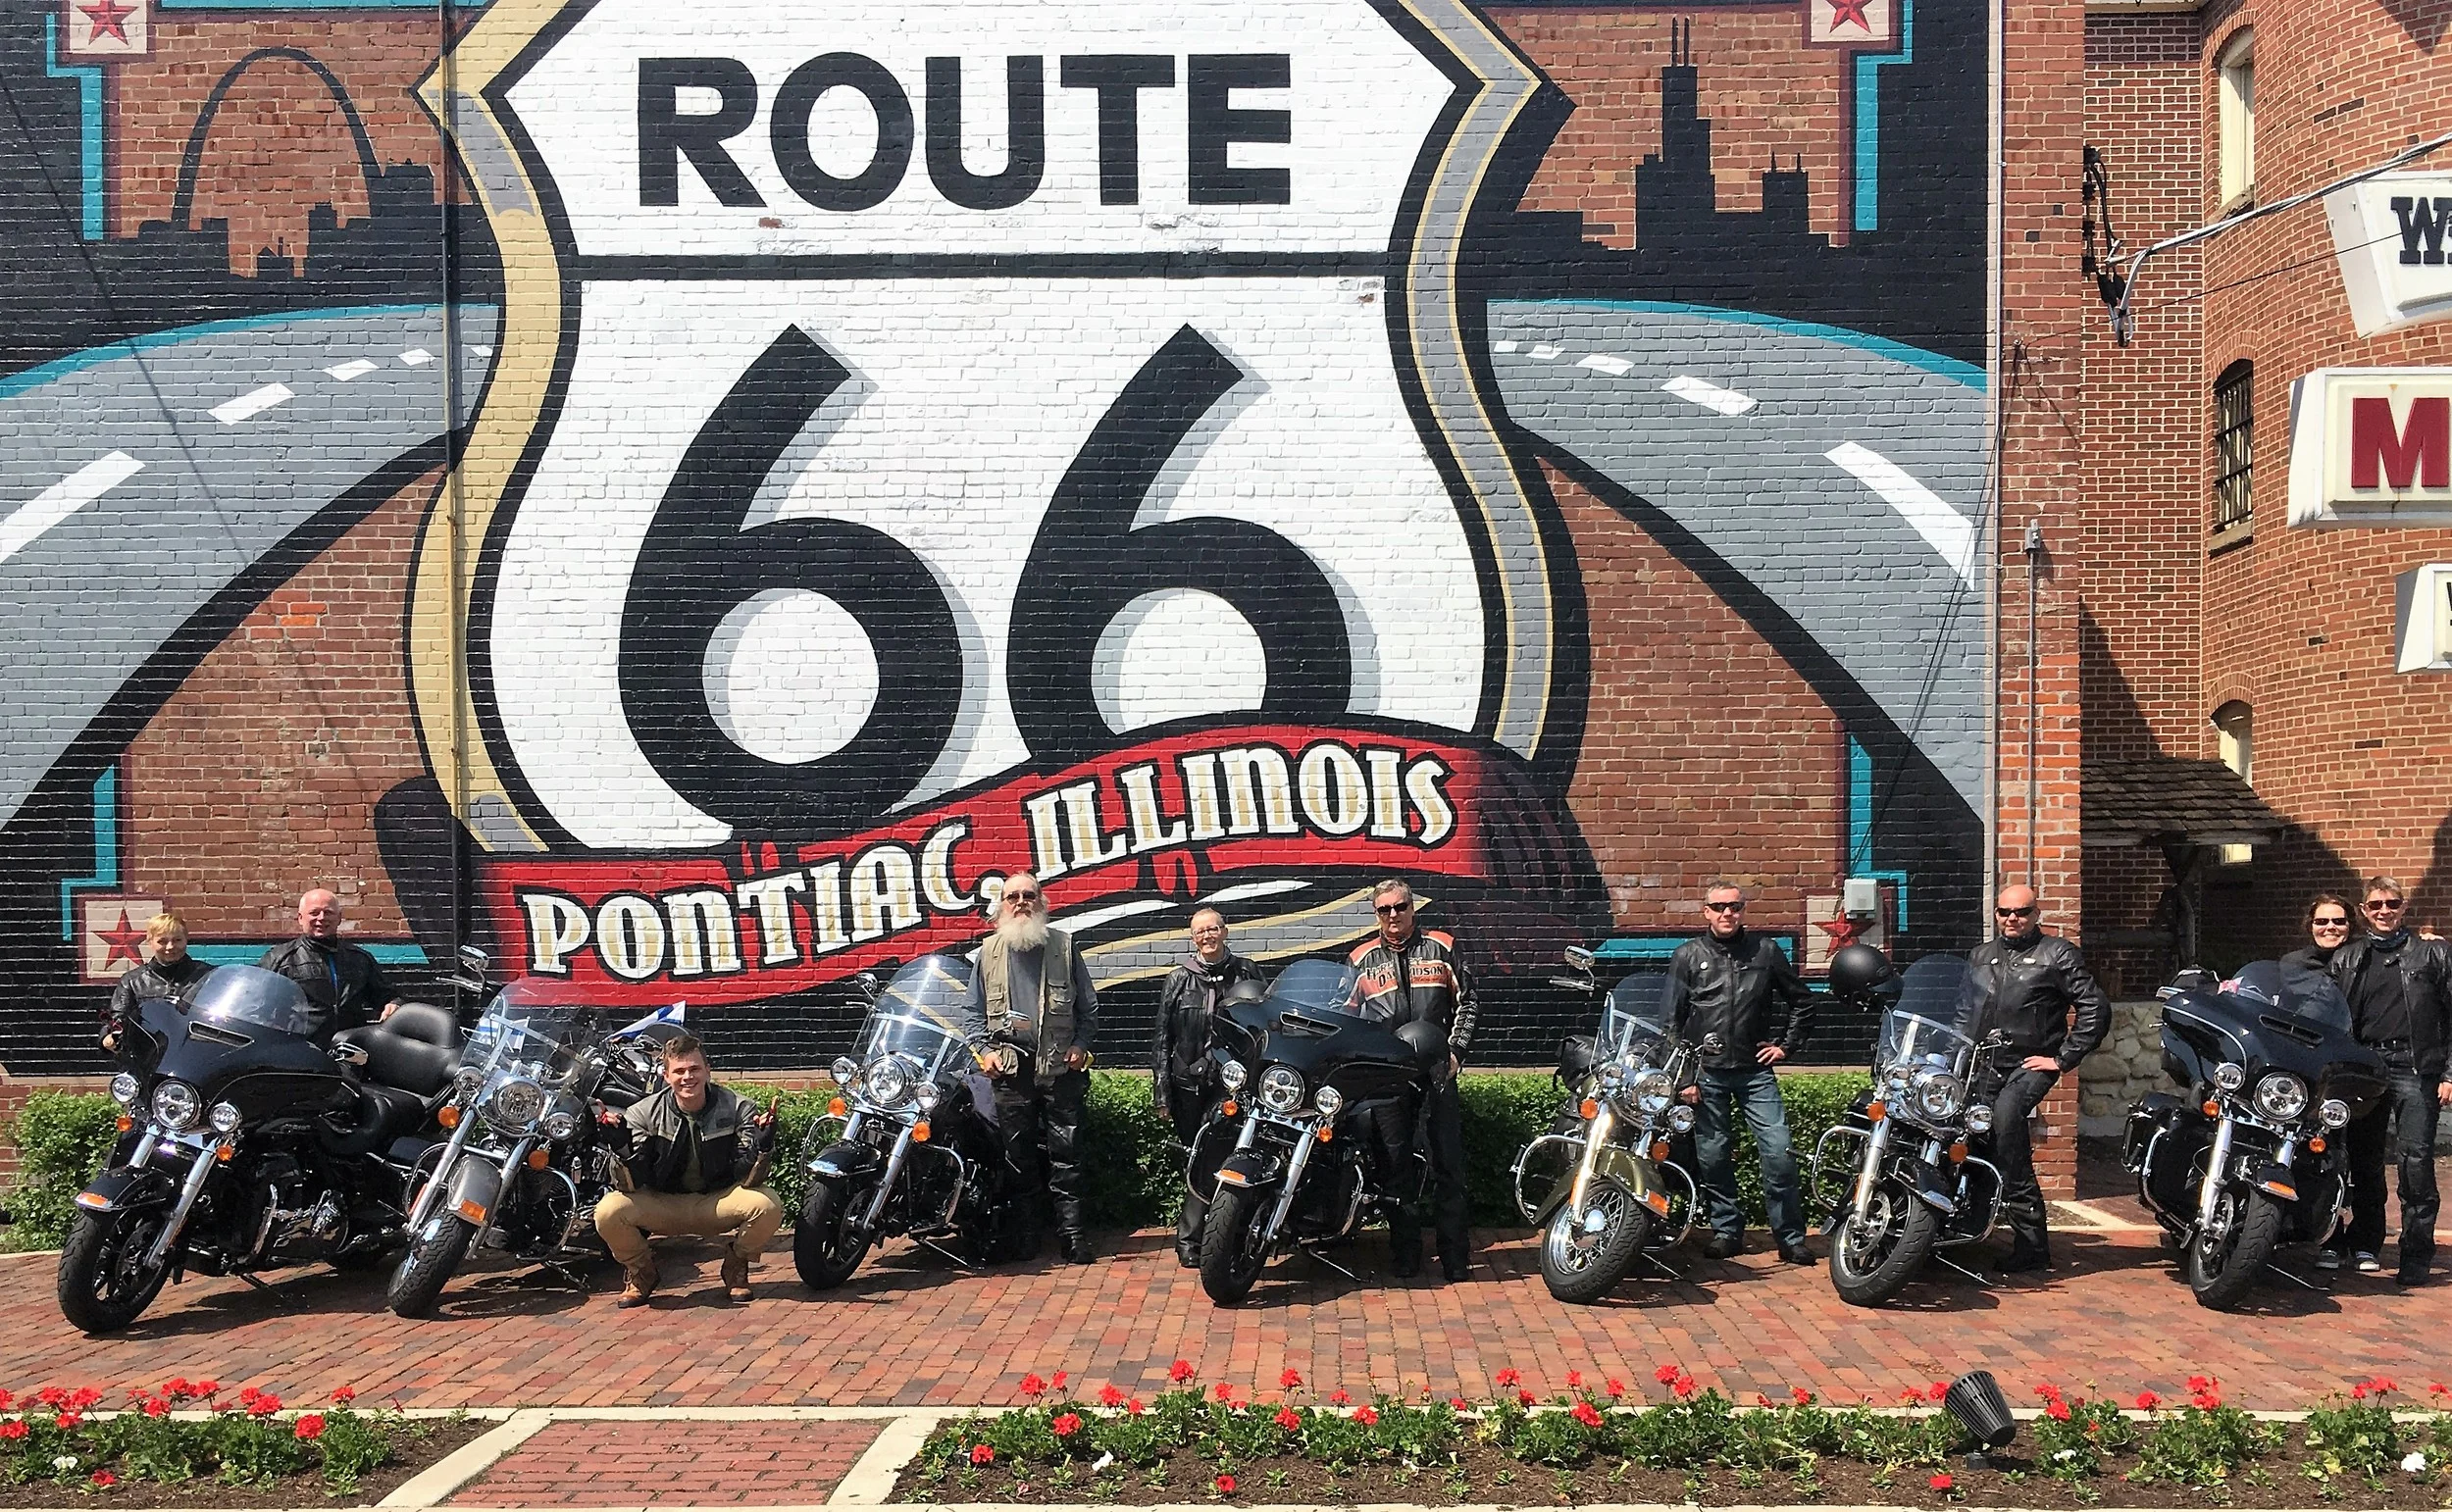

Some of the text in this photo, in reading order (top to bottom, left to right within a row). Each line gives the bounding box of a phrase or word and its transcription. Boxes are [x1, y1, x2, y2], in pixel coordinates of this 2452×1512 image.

[638, 52, 1291, 212] ROUTE
[2390, 196, 2452, 265] W
[618, 323, 1365, 832] 66
[1027, 741, 1453, 882] ILLINOIS
